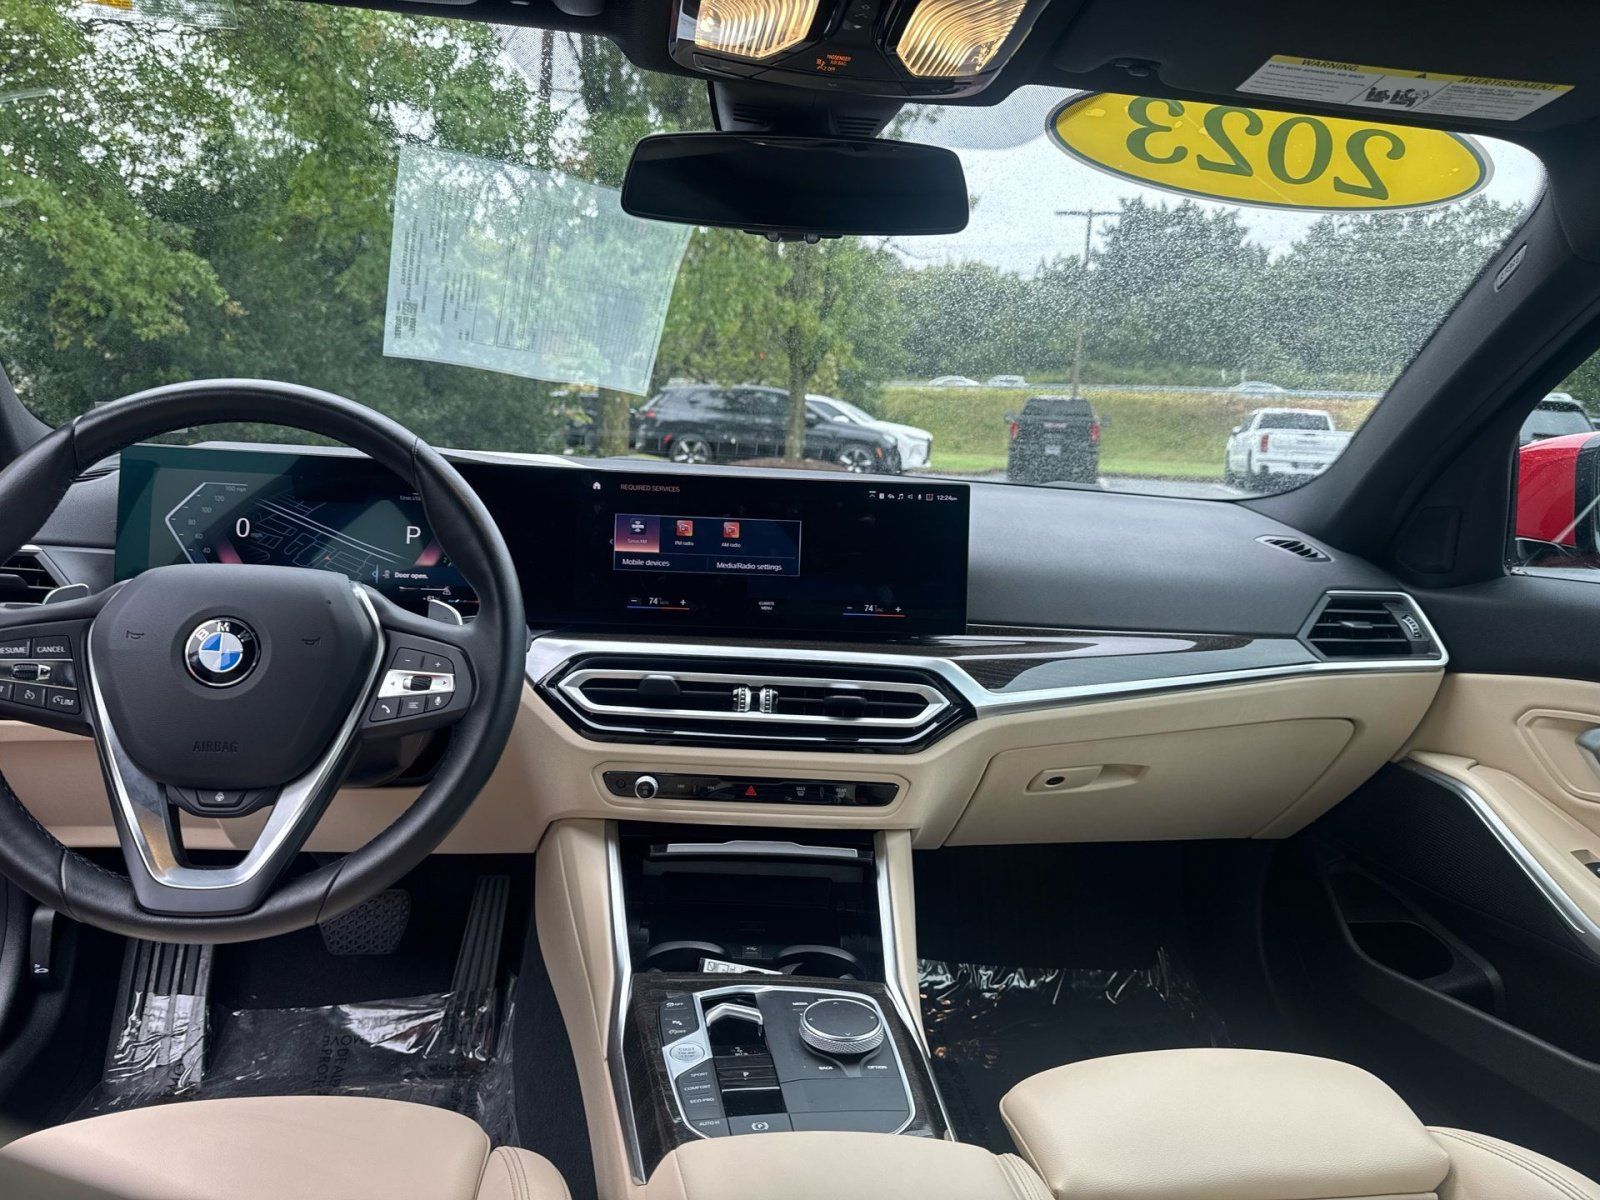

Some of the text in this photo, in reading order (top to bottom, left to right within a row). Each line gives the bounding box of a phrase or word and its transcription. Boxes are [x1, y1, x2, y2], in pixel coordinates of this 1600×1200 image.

[1302, 59, 1360, 72] WARNING
[1459, 76, 1557, 91] AVERTISSEMENT
[620, 483, 681, 493] REQUIRED SERVICES
[235, 517, 250, 538] 0
[406, 525, 421, 545] P
[622, 558, 671, 567] Mobile devices
[716, 561, 783, 572] Media/Radio settings
[410, 572, 428, 580] open.
[648, 597, 659, 606] 74
[864, 604, 874, 612] 74
[195, 621, 251, 643] BMW
[0, 646, 27, 654] ESUME
[192, 739, 239, 753] AIRBAG
[684, 1084, 711, 1092] COMFORT
